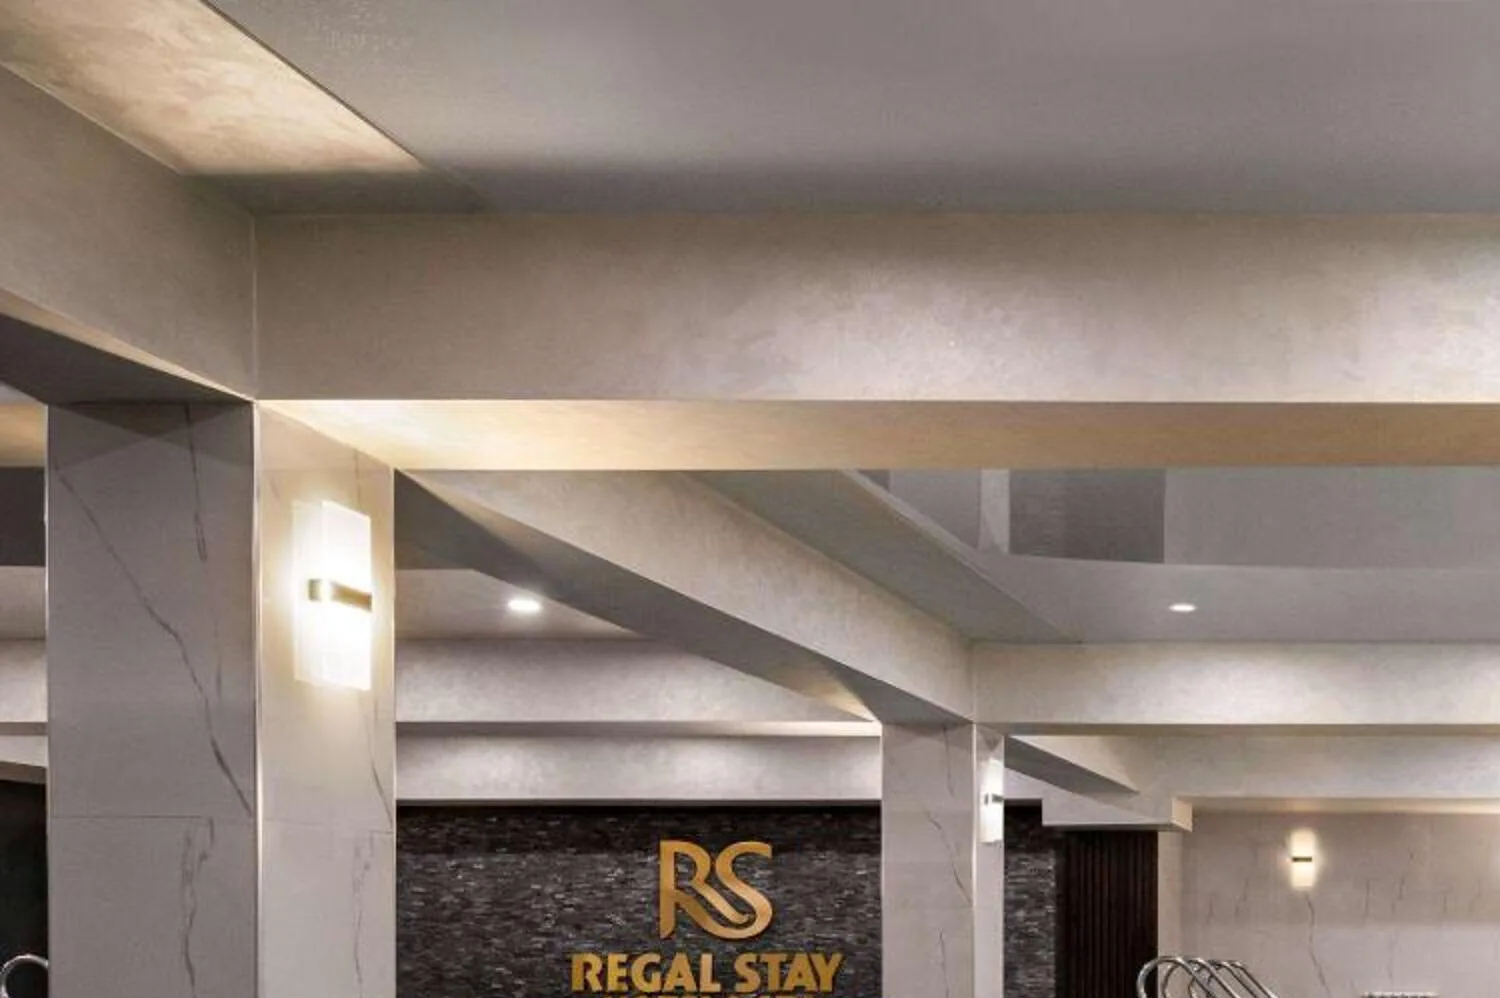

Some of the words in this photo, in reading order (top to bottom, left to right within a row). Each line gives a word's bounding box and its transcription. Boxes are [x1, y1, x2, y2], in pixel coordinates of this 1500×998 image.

[659, 840, 773, 939] RS
[571, 952, 721, 993] REGAL
[734, 952, 842, 993] STAY
